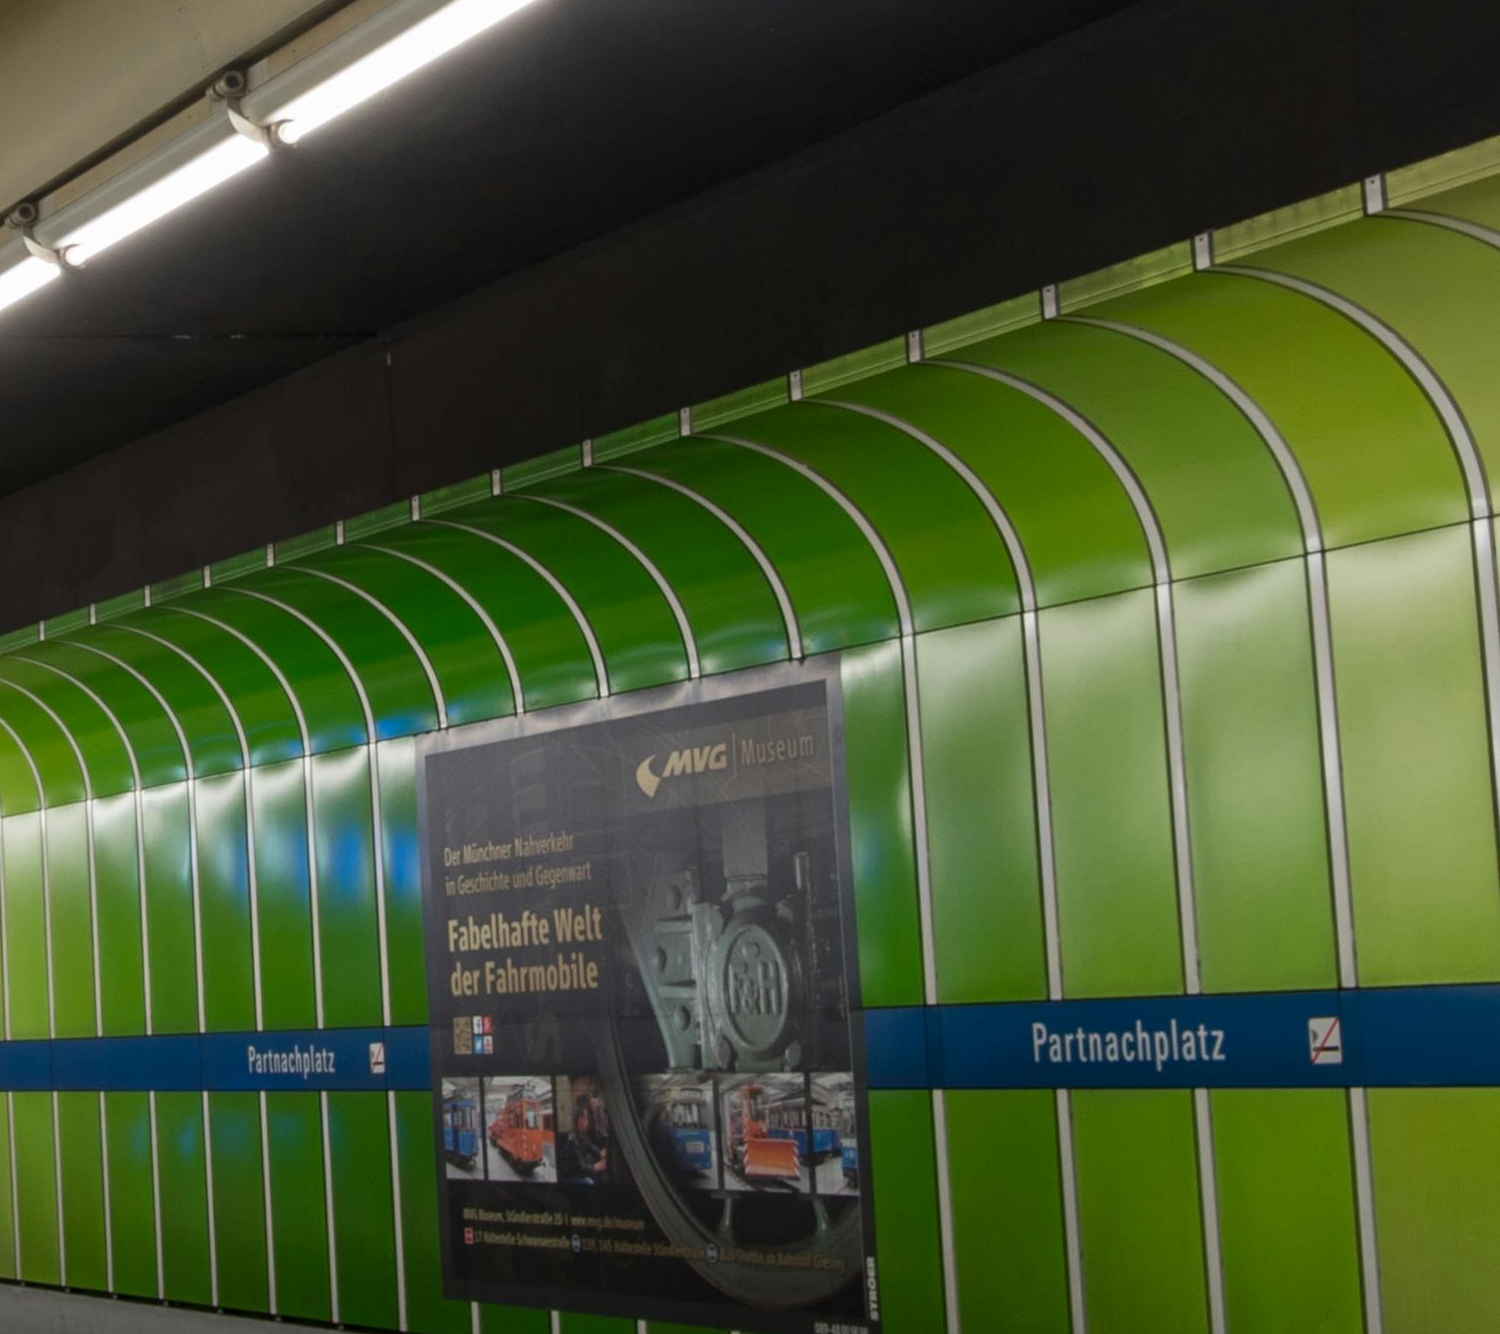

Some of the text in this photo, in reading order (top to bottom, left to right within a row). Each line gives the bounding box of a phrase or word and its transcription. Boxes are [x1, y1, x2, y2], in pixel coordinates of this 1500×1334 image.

[661, 734, 815, 778] MVG Museum
[443, 831, 575, 867] Der Münchner Nahverkehr
[445, 861, 592, 896] in Geschichte und Gegenwart
[447, 904, 604, 952] Fabelhafte Welt
[451, 952, 599, 997] der Fahrmobile
[248, 1044, 336, 1080] Partnachplatz
[1031, 1019, 1226, 1072] Partnachplatz
